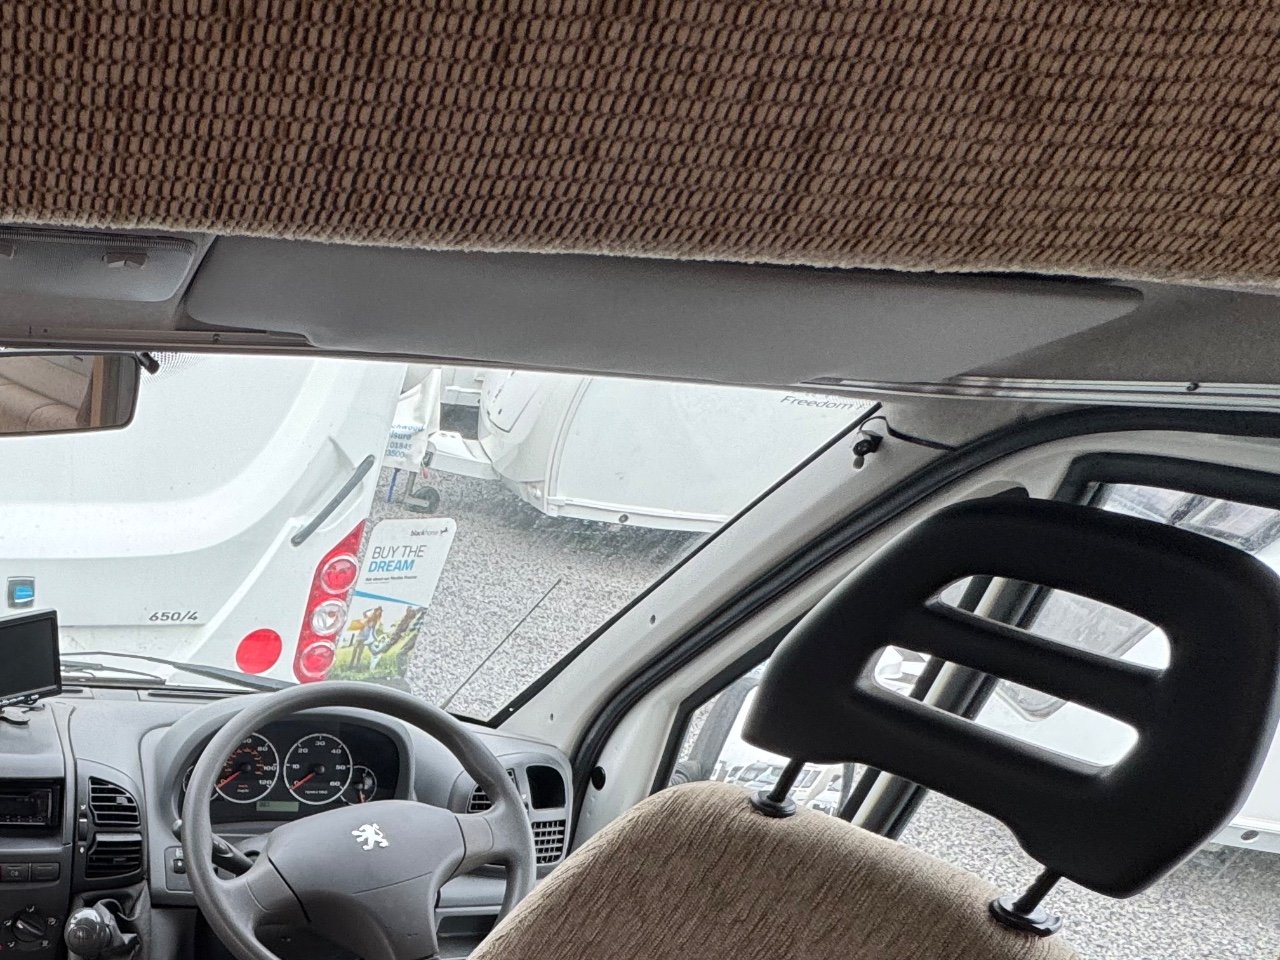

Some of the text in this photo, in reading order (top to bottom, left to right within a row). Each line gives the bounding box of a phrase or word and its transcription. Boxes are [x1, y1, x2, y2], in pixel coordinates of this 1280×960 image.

[780, 395, 854, 410] Freedom
[372, 544, 428, 560] BUY THE
[368, 559, 415, 573] DREAM
[149, 610, 199, 623] 650/4
